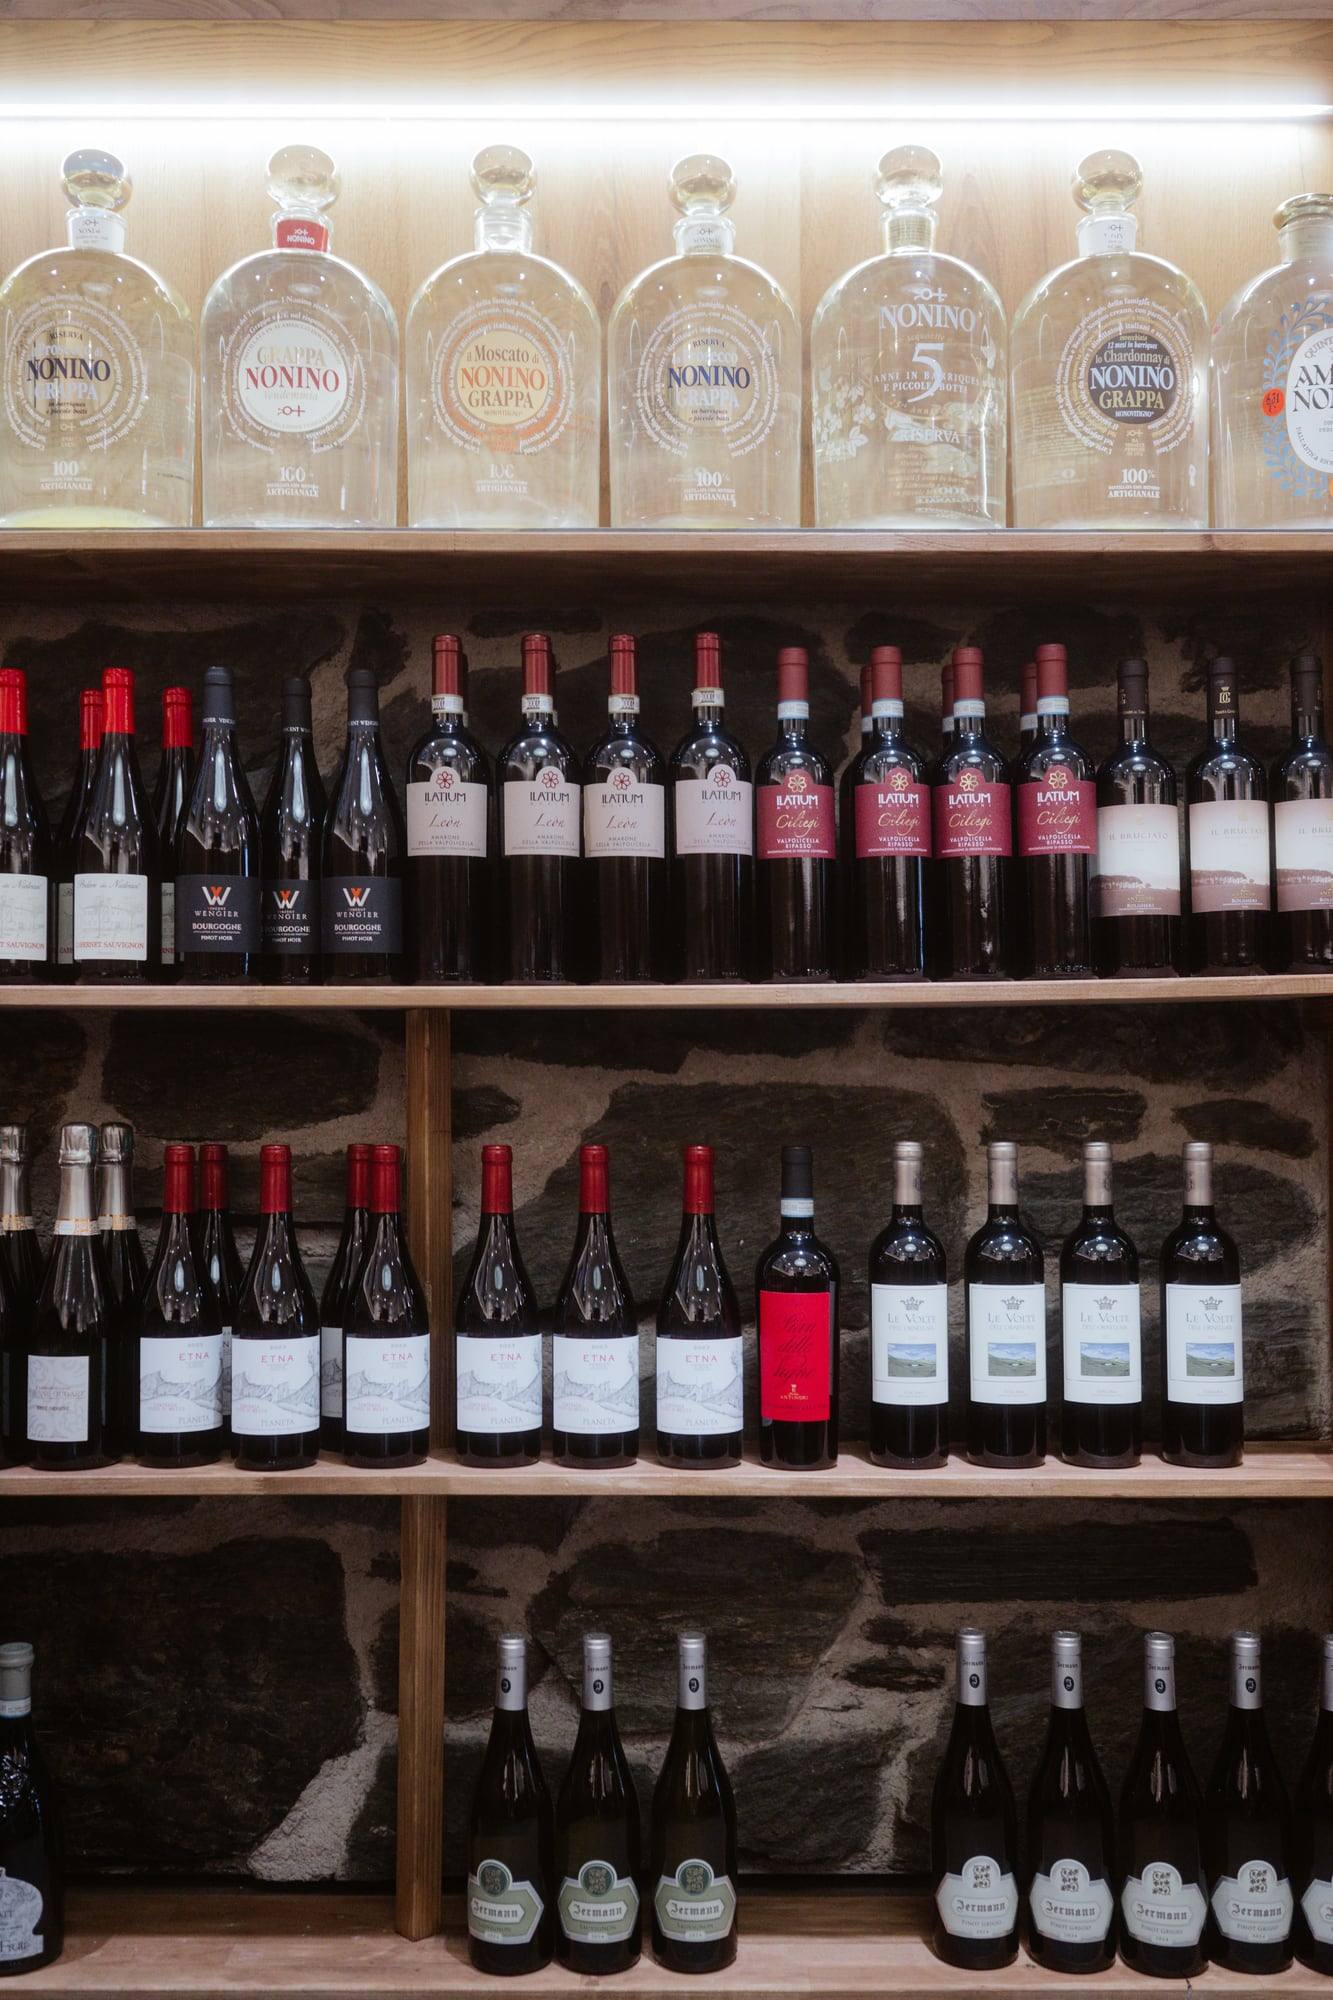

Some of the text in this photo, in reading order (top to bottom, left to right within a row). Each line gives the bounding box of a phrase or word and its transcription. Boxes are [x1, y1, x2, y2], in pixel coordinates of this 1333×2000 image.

[879, 303, 977, 332] NONINO
[257, 346, 327, 367] GRAPPA
[475, 344, 530, 361] Moscato
[1096, 349, 1170, 365] lo Chardonnay di
[26, 358, 111, 382] NONINO
[669, 364, 750, 389] NONINO
[908, 342, 945, 403] 5
[245, 365, 340, 392] NONINO
[461, 365, 545, 391] NONINO
[874, 371, 979, 385] ANNI IN BARIQUES
[1090, 364, 1174, 390] NONINO
[884, 384, 890, 392] E
[468, 389, 534, 408] GRAPPA
[676, 388, 741, 407] GRAPPA
[1099, 389, 1165, 408] GRAPPA
[40, 482, 92, 490] ARTIGIANALE
[266, 487, 319, 498] ARTIGIANALE
[683, 492, 736, 503] ARTIGIANALE
[1108, 490, 1160, 499] ARTIGIANALE
[776, 810, 821, 838] Ciliegi
[877, 809, 921, 836] Ciliegi
[948, 809, 993, 836] Ciliegi
[1036, 806, 1081, 834] Ciliegi
[950, 835, 993, 843] VALPOLICELLA
[1037, 833, 1081, 841] VALPOLICELLA
[192, 922, 242, 931] BOURGOGNE
[103, 941, 145, 950] SAUVIGNON
[888, 1312, 936, 1324] LE VOLTE
[988, 1312, 1036, 1324] LE VOLTE
[1080, 1312, 1130, 1323] LE VOLTE
[1186, 1312, 1234, 1323] LE VOLTE
[179, 1352, 209, 1360] ETNA
[261, 1354, 295, 1364] ETNA
[382, 1352, 414, 1362] ETNA
[491, 1352, 522, 1362] ETNA
[583, 1354, 616, 1363] ETNA
[686, 1354, 718, 1363] ETNA
[261, 1417, 296, 1427] PLANETA
[382, 1416, 414, 1425] PLANETA
[491, 1417, 523, 1425] PLANETA
[583, 1417, 616, 1425] PLANETA
[473, 1900, 518, 1918] Jermann
[572, 1903, 623, 1916] Jermann
[671, 1902, 721, 1916] Jermann
[957, 1899, 1006, 1914] Jermann
[1046, 1901, 1096, 1916] Jermann
[1136, 1903, 1188, 1920] Jermann
[1232, 1903, 1282, 1918] Jermann
